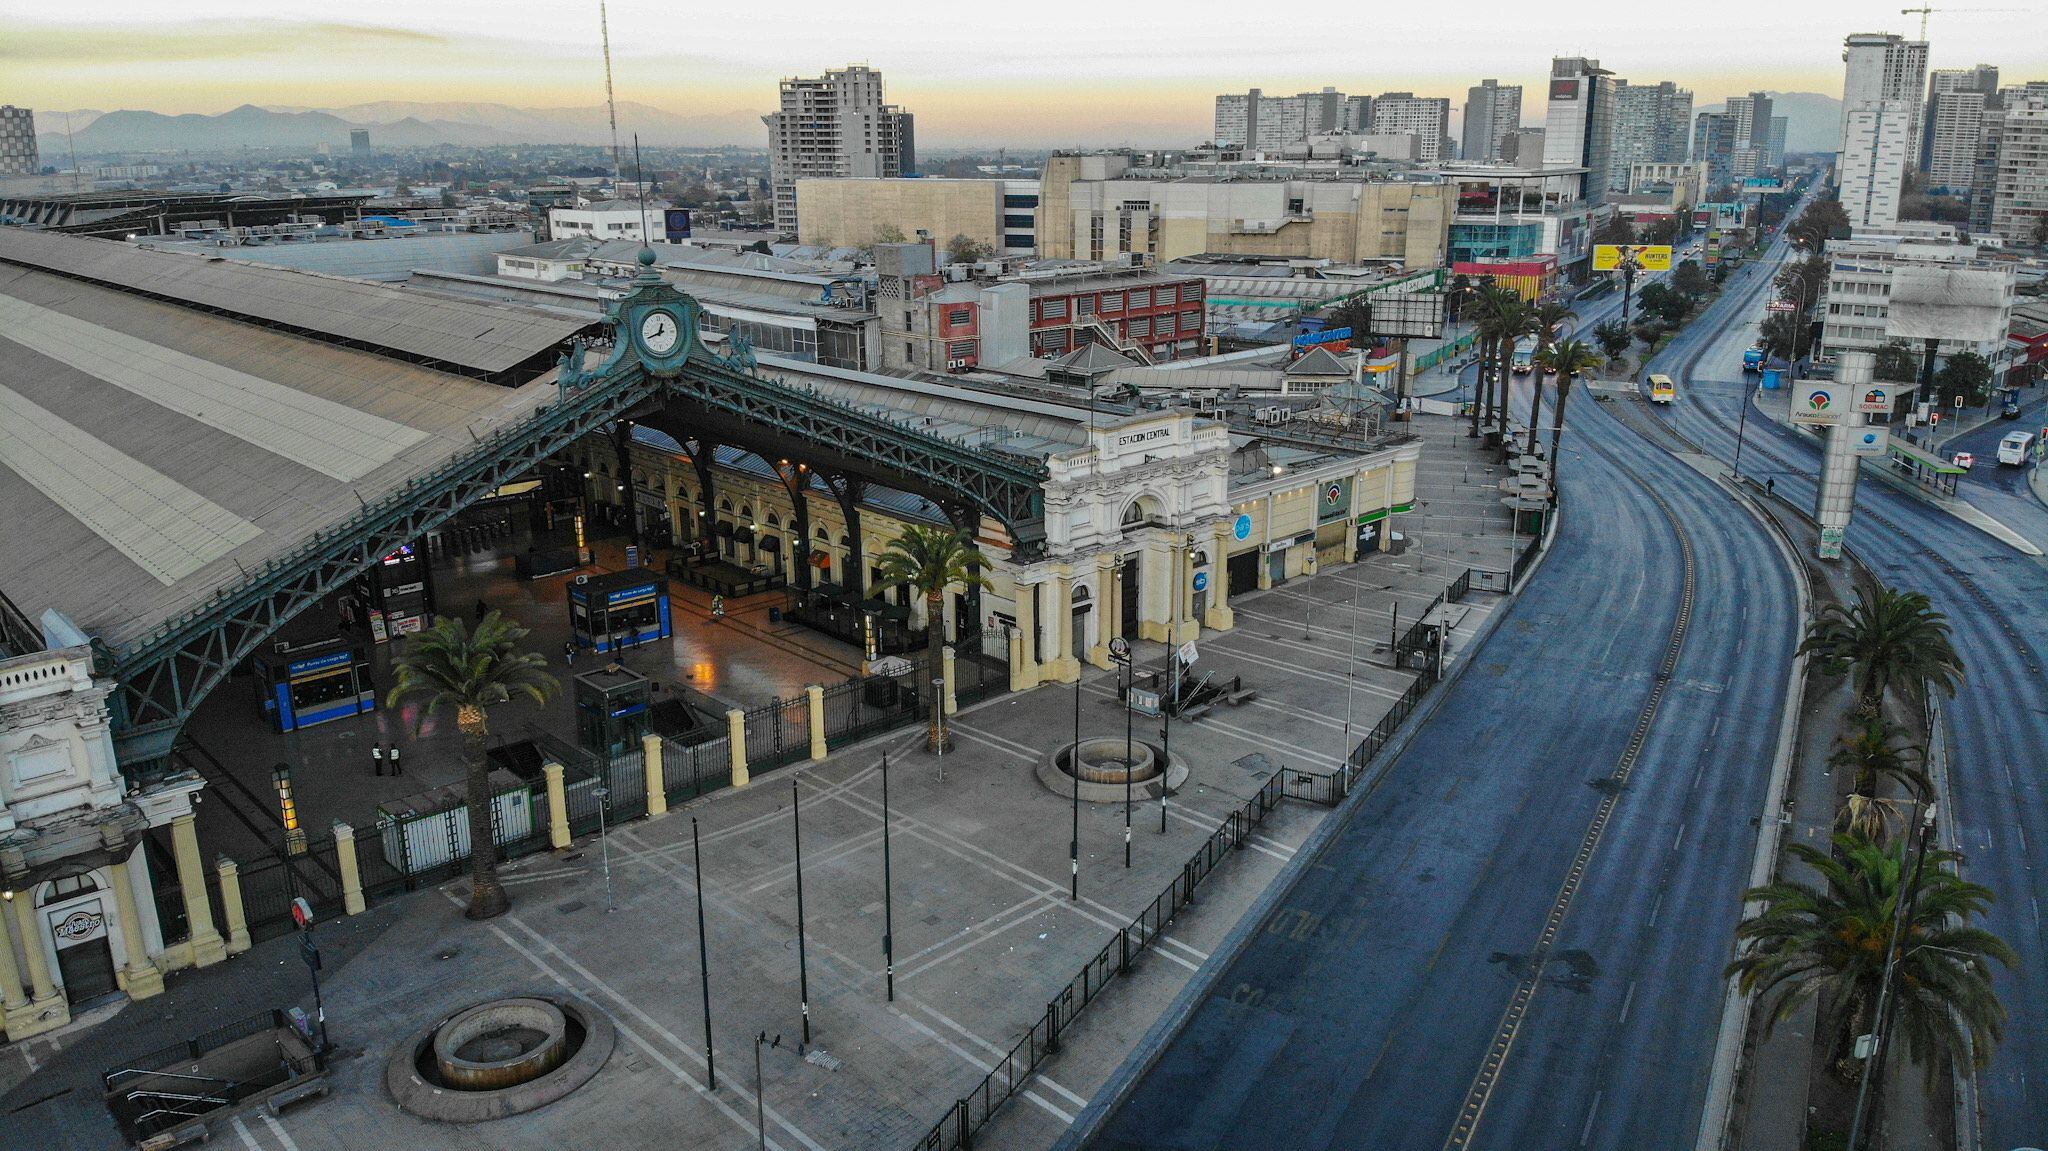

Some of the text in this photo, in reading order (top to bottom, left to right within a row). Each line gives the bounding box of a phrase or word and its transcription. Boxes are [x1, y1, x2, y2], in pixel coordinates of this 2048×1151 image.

[1119, 428, 1170, 446] ESTACION CENTRAL
[56, 917, 101, 938] Maestro
